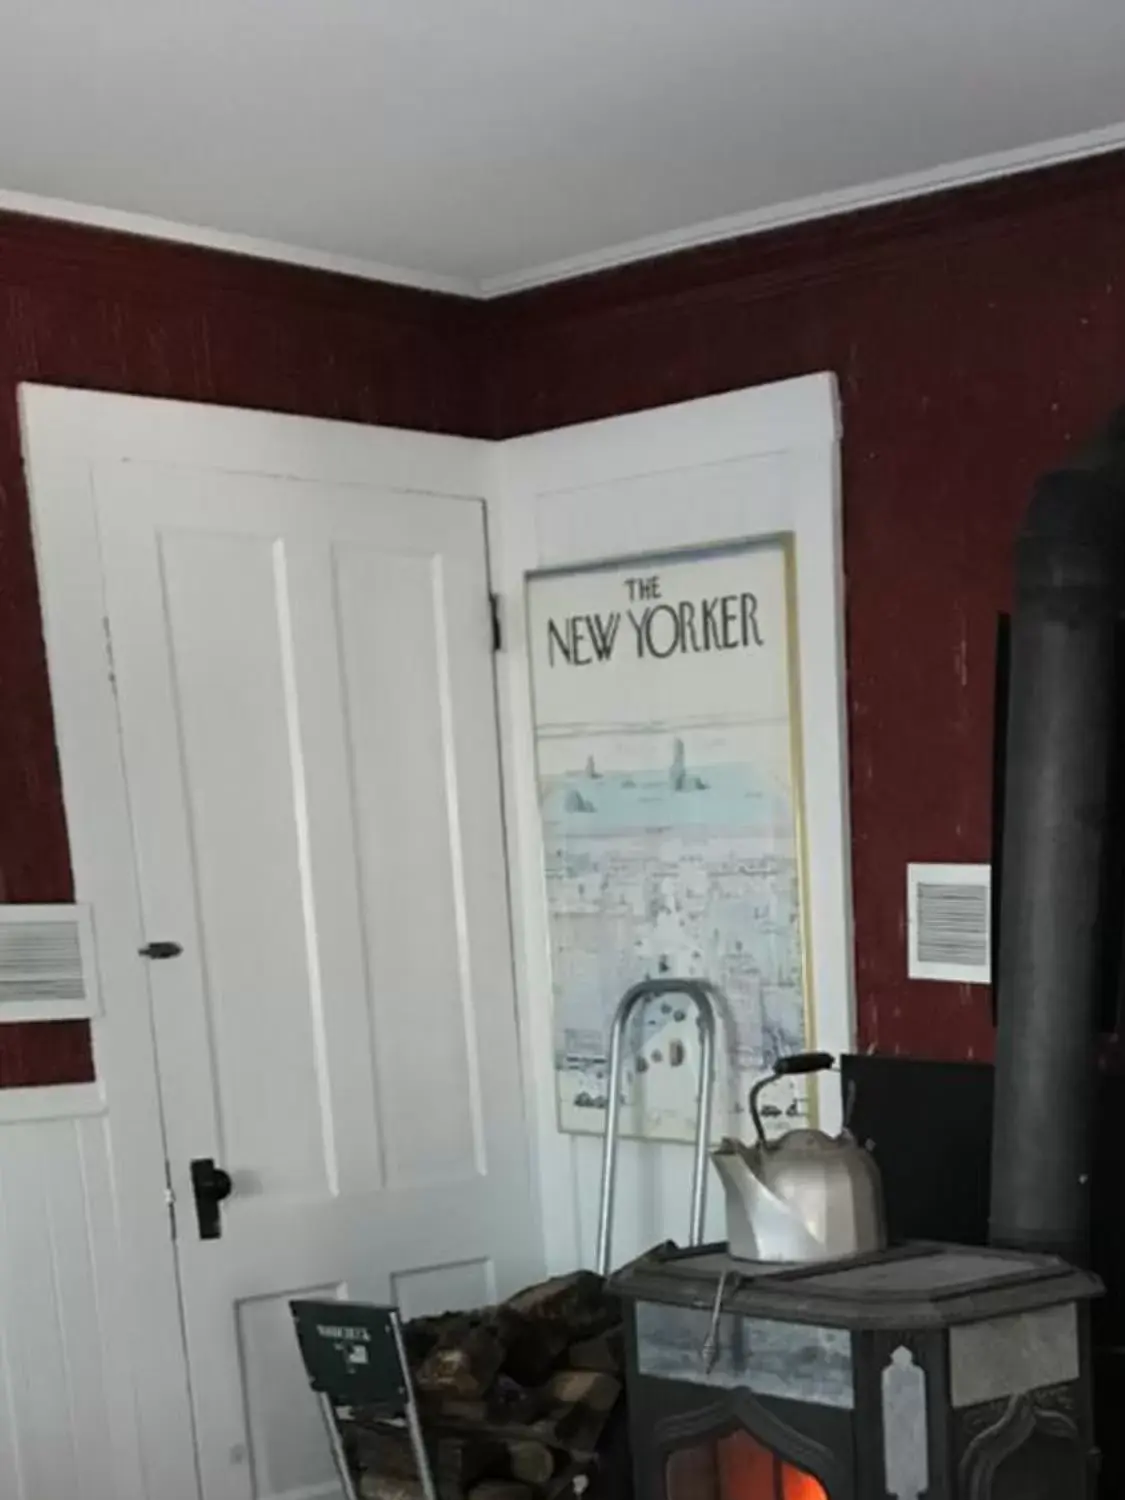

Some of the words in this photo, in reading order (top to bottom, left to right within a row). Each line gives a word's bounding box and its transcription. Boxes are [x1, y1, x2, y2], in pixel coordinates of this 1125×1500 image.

[624, 576, 662, 601] THE
[548, 611, 622, 668] NEW
[627, 593, 764, 658] YORKER
